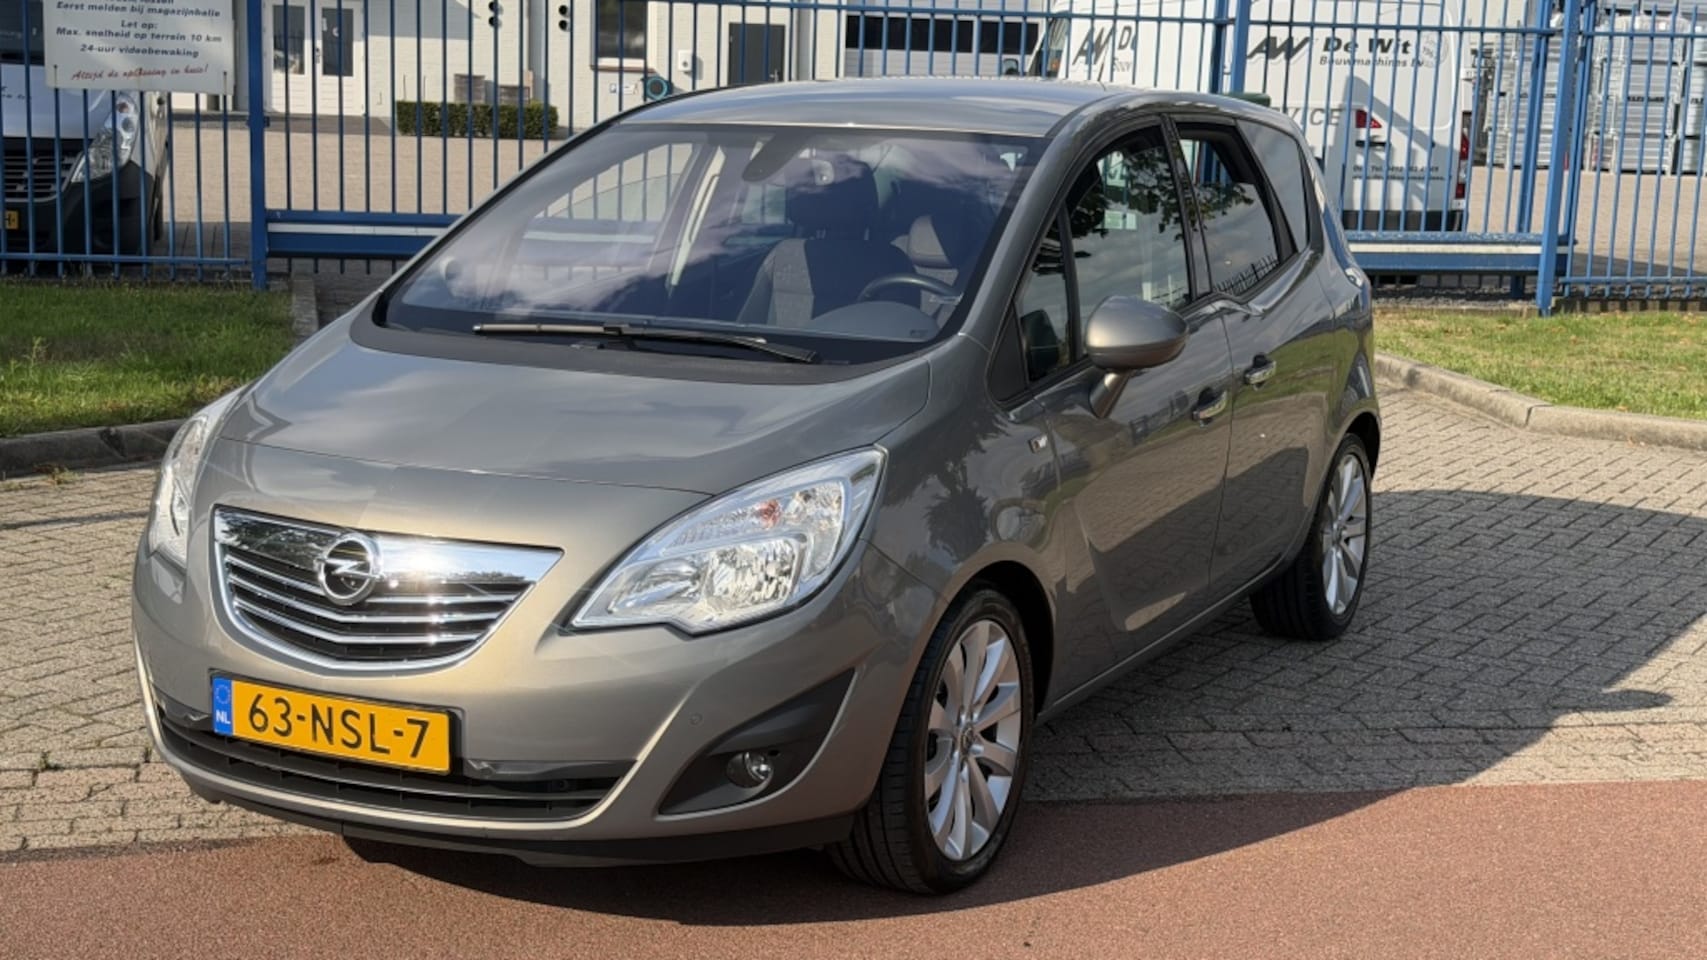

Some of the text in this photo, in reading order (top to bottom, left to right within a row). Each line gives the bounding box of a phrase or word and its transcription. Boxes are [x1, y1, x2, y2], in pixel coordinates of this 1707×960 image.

[56, 1, 84, 10] Eerst
[88, 4, 127, 12] melden
[130, 5, 144, 14] bij
[121, 20, 138, 28] Let
[85, 29, 131, 38] snelheid
[134, 32, 148, 40] op
[80, 43, 199, 58] 24-uur videobewaking
[1323, 37, 1358, 53] De
[1320, 56, 1407, 67] Buwmahins
[215, 709, 231, 724] NL
[248, 694, 430, 758] 63-NSL-7
